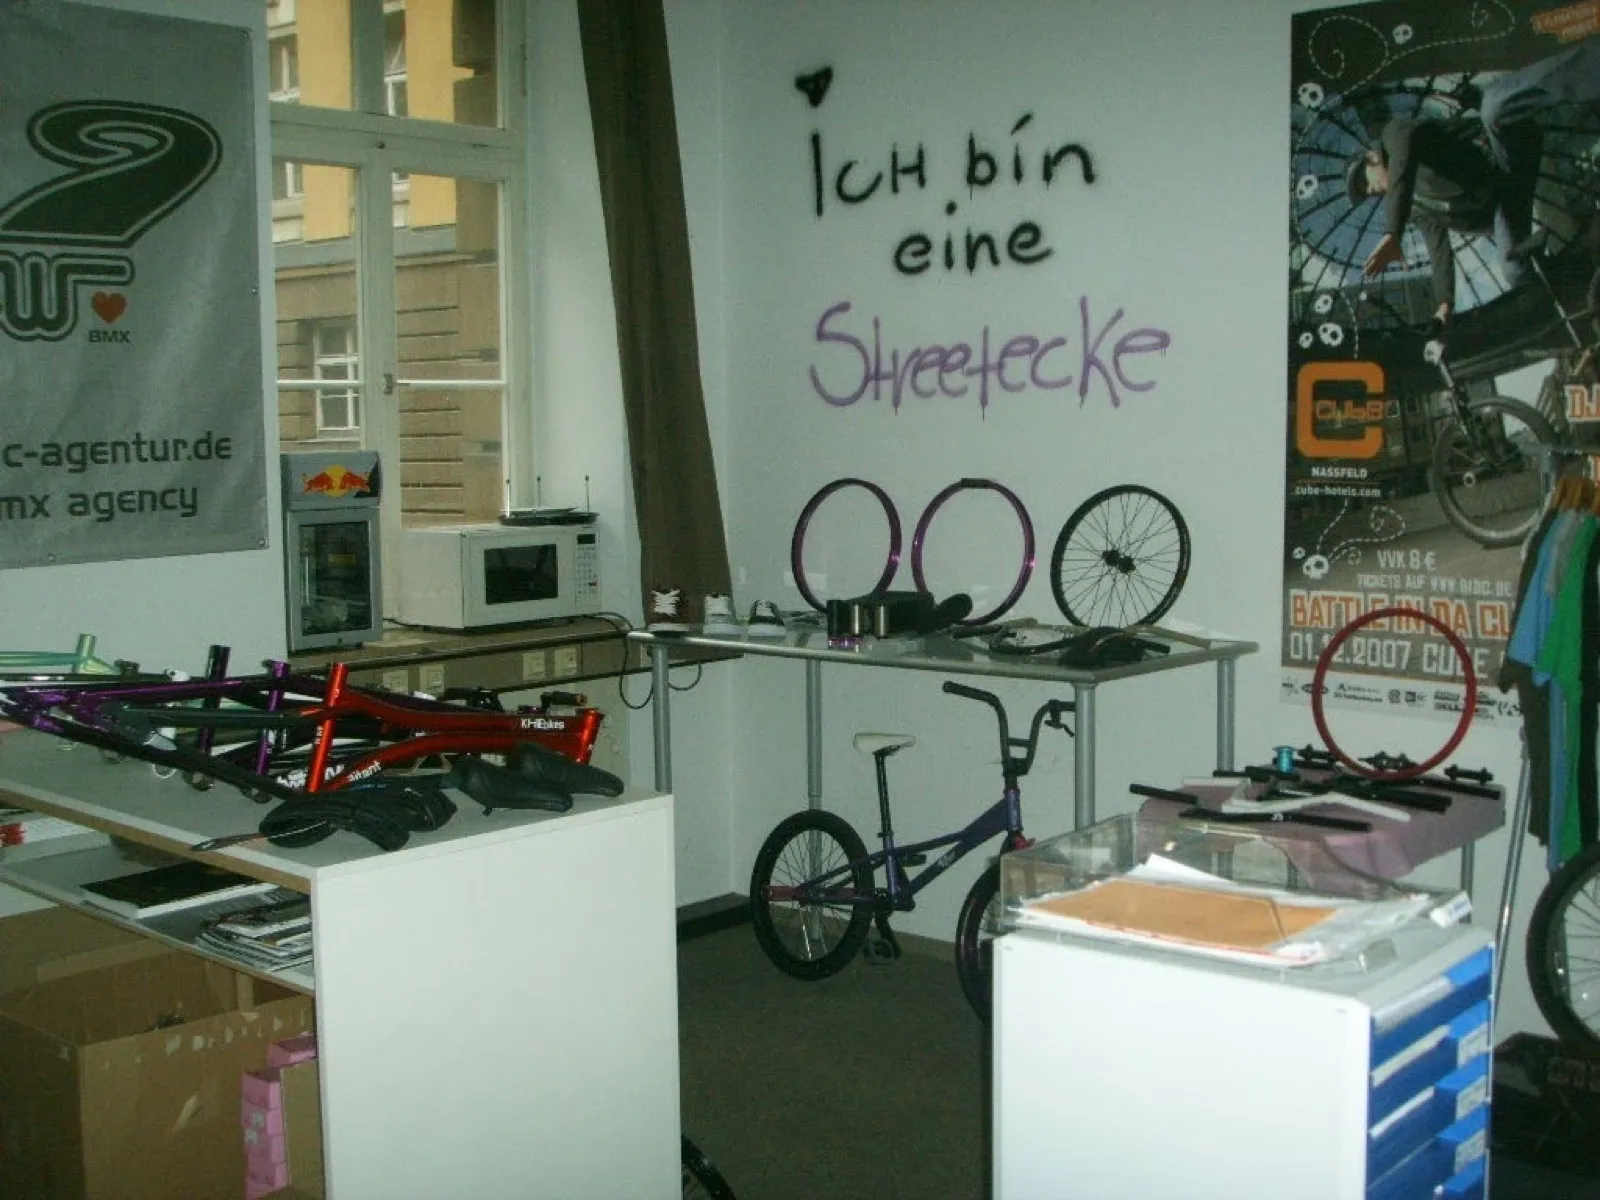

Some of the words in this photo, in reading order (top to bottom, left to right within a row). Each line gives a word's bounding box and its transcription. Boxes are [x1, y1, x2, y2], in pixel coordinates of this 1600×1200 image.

[894, 201, 1053, 275] eine
[88, 330, 131, 342] BMX
[4, 430, 232, 474] c-agentur.de
[1311, 466, 1368, 478] NASSFELD
[67, 486, 199, 523] agency
[1289, 589, 1389, 632] BATTLE
[1394, 593, 1425, 634] IN
[1430, 596, 1473, 639] DA
